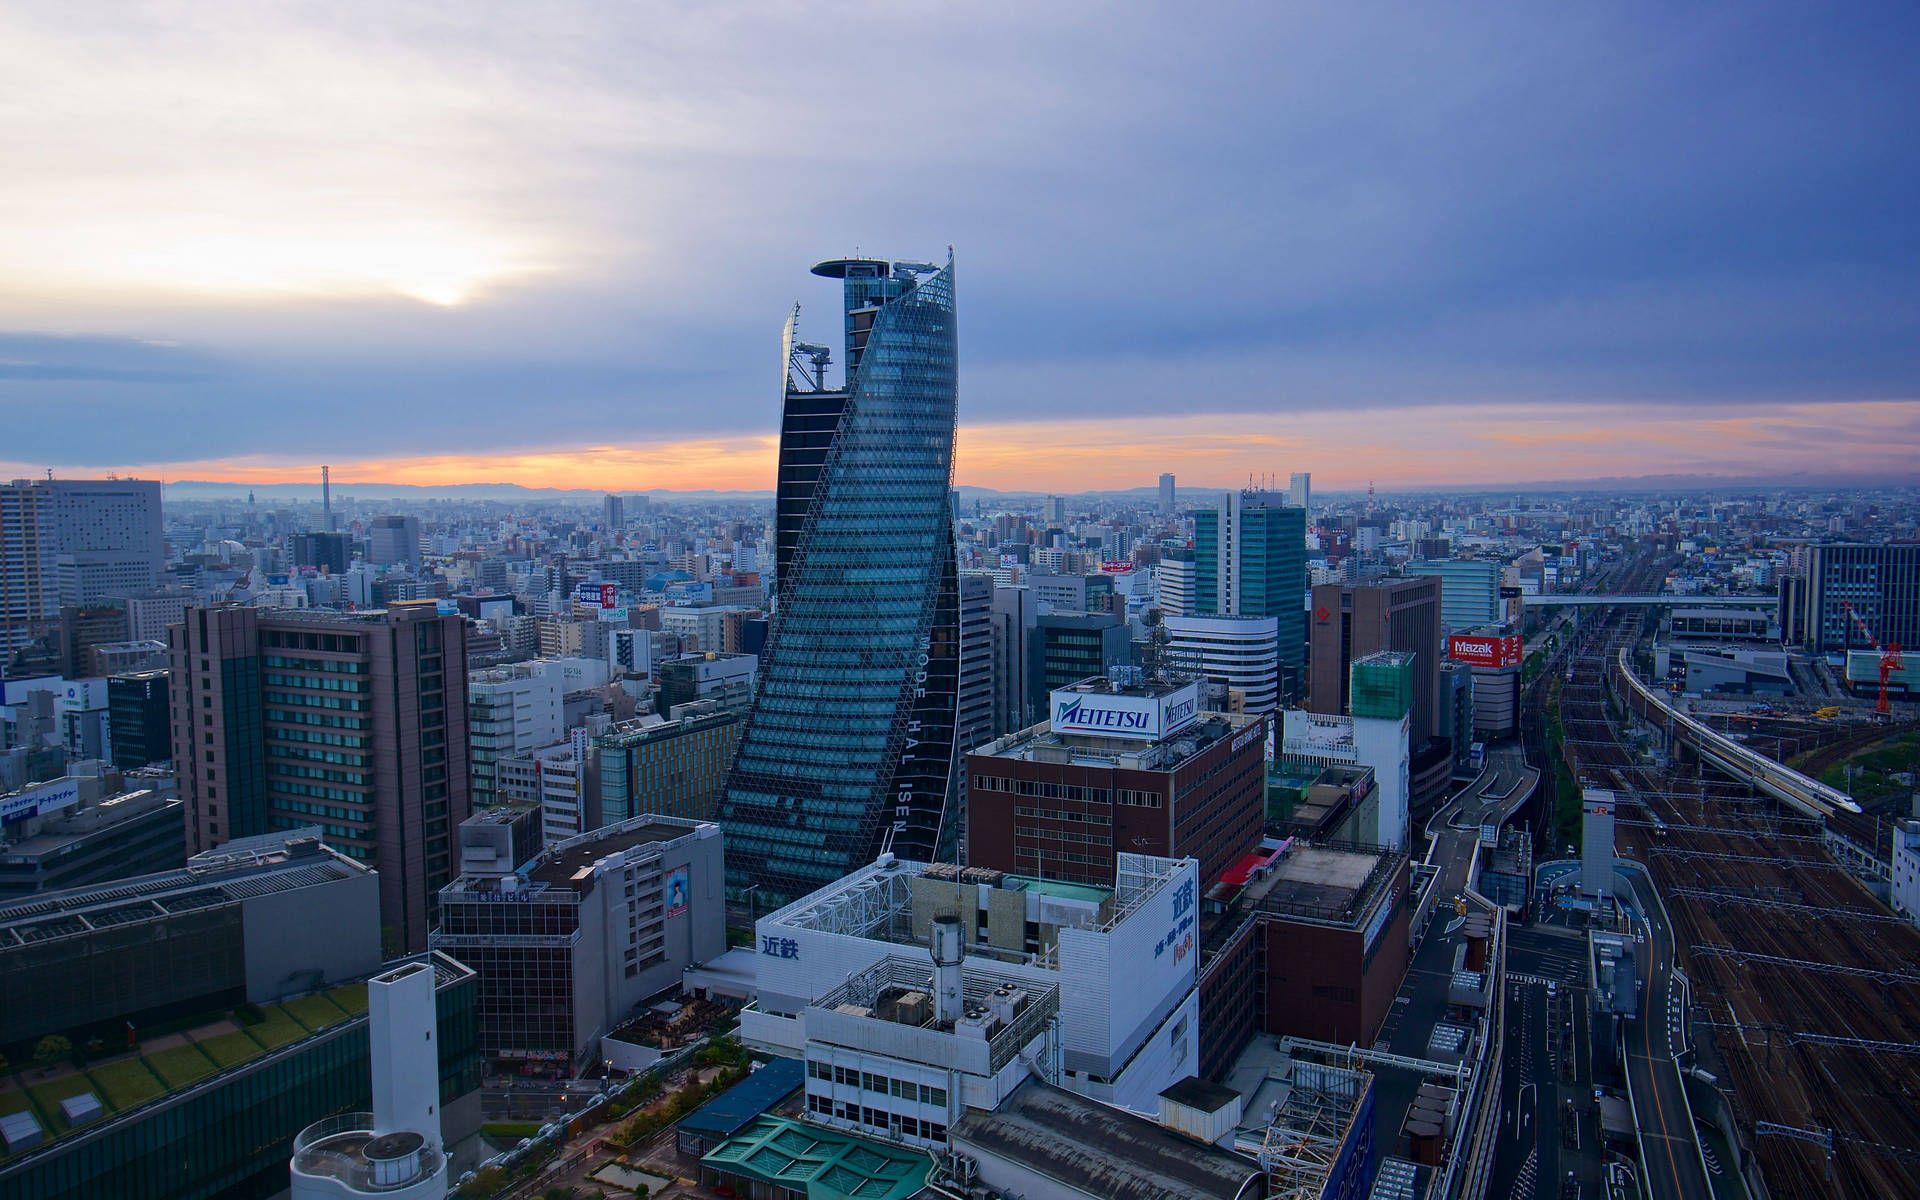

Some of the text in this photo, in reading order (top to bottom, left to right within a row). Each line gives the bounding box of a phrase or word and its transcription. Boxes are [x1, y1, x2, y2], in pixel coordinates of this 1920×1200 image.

[1455, 641, 1493, 654] Mazak
[1056, 695, 1150, 728] MEITETSU
[1164, 695, 1194, 726] MEITETSU
[893, 634, 931, 832] MODE HAL ISEN
[1592, 806, 1607, 814] JR
[1173, 877, 1194, 921] 近鉄
[762, 935, 799, 960] 近鉄
